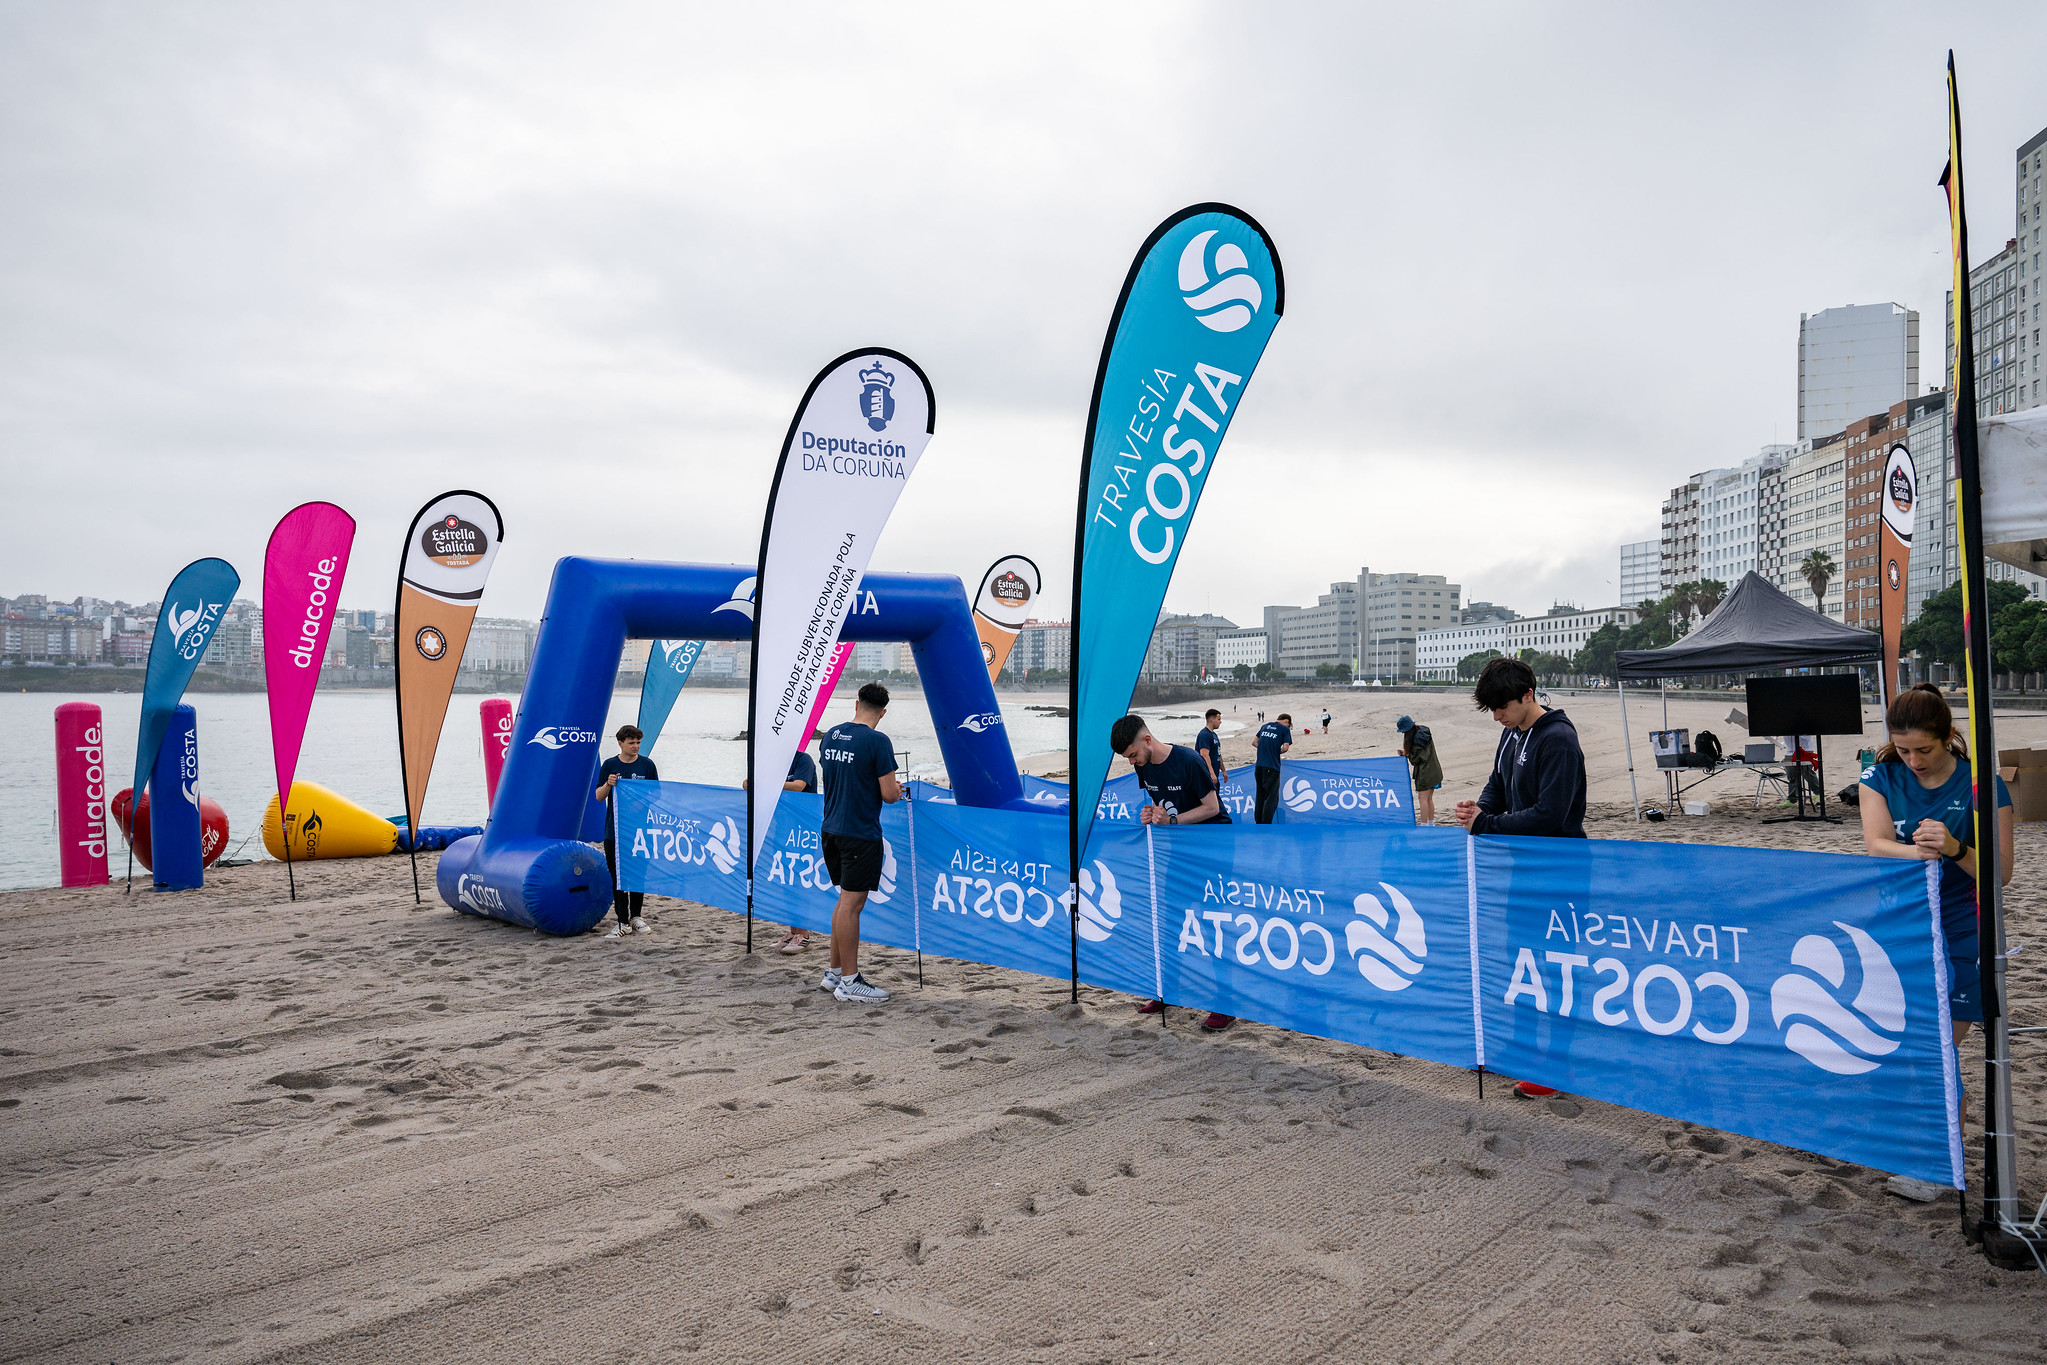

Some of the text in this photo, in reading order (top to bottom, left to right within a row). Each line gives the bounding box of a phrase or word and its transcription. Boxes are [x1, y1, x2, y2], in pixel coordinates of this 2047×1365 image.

[802, 431, 906, 458] Deputación
[1093, 367, 1176, 528] TRAVESÍA
[803, 453, 906, 480] DA CORUÑA
[1129, 361, 1242, 565] COSTA
[432, 528, 476, 541] Estrella
[435, 540, 475, 553] Galicia
[997, 579, 1024, 591] Estrella
[998, 588, 1023, 598] Galicia
[288, 555, 338, 668] duacode.
[184, 603, 223, 660] COSTA
[771, 532, 856, 736] ACTIVIDADE SUBVENCIONADA POLA
[794, 568, 857, 715] DEPUTACIÓN DA CORUÑA
[676, 640, 702, 673] COST
[981, 715, 1003, 726] COST
[559, 731, 597, 743] COSTA
[1261, 731, 1278, 739] STAFF
[184, 728, 197, 778] COSTA
[824, 748, 855, 764] STAFF
[75, 722, 106, 859] duacode.
[1321, 776, 1384, 789] TRAVESÍA
[1098, 803, 1131, 820] STA
[1223, 795, 1256, 815] STA
[1322, 789, 1401, 810] COSTA
[201, 824, 220, 858] Cola
[471, 883, 507, 912] COSTA
